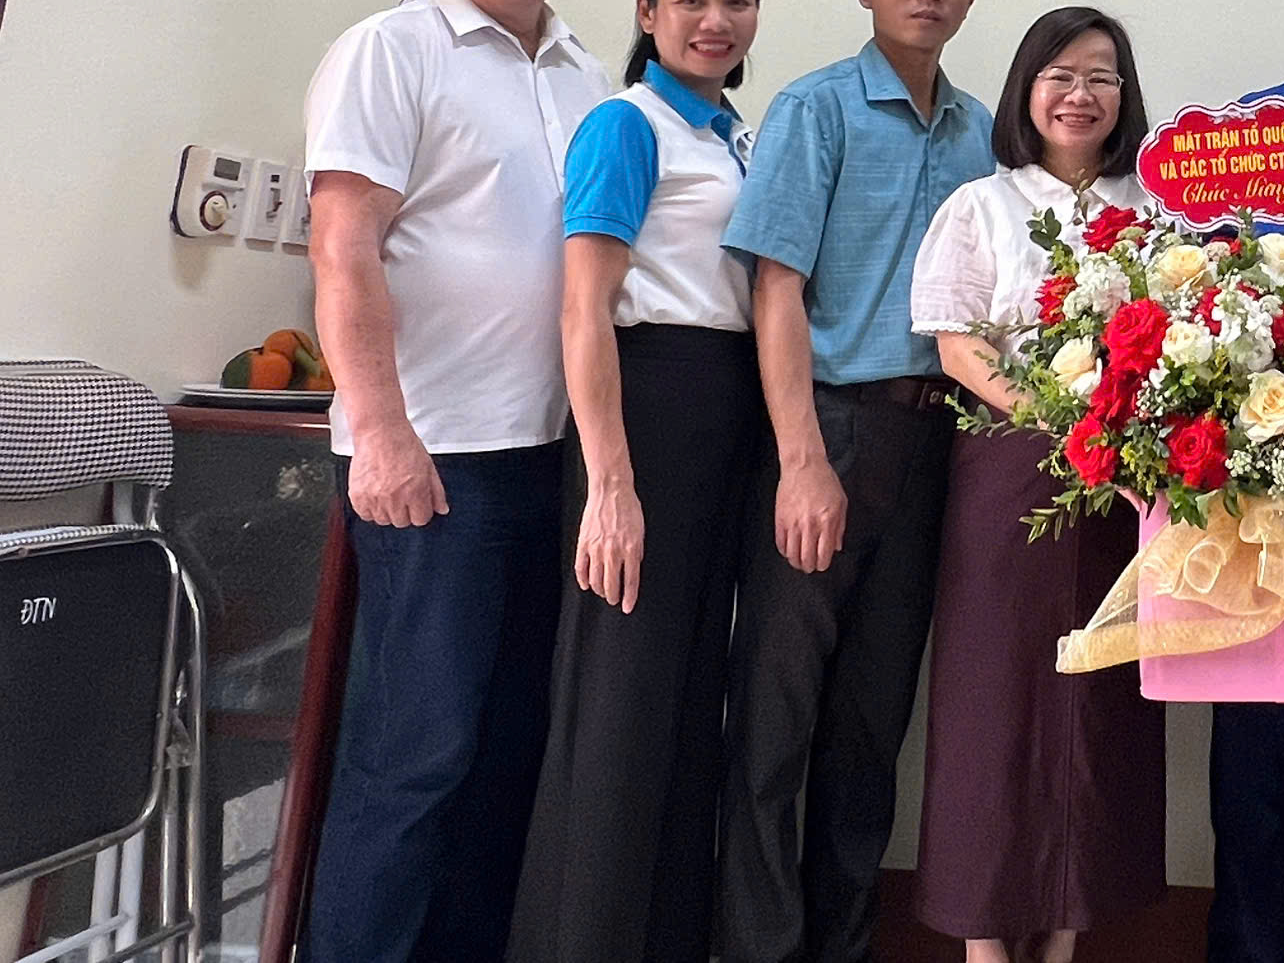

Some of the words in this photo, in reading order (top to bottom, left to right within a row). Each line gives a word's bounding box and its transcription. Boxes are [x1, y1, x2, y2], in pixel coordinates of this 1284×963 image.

[1173, 130, 1201, 155] MẶT
[1160, 158, 1178, 180] VÀ
[1181, 156, 1207, 178] CÁC
[1230, 150, 1266, 174] CHỨC
[1269, 152, 1284, 170] CT
[1182, 182, 1230, 204] Chúc
[21, 597, 57, 625] ĐTN
